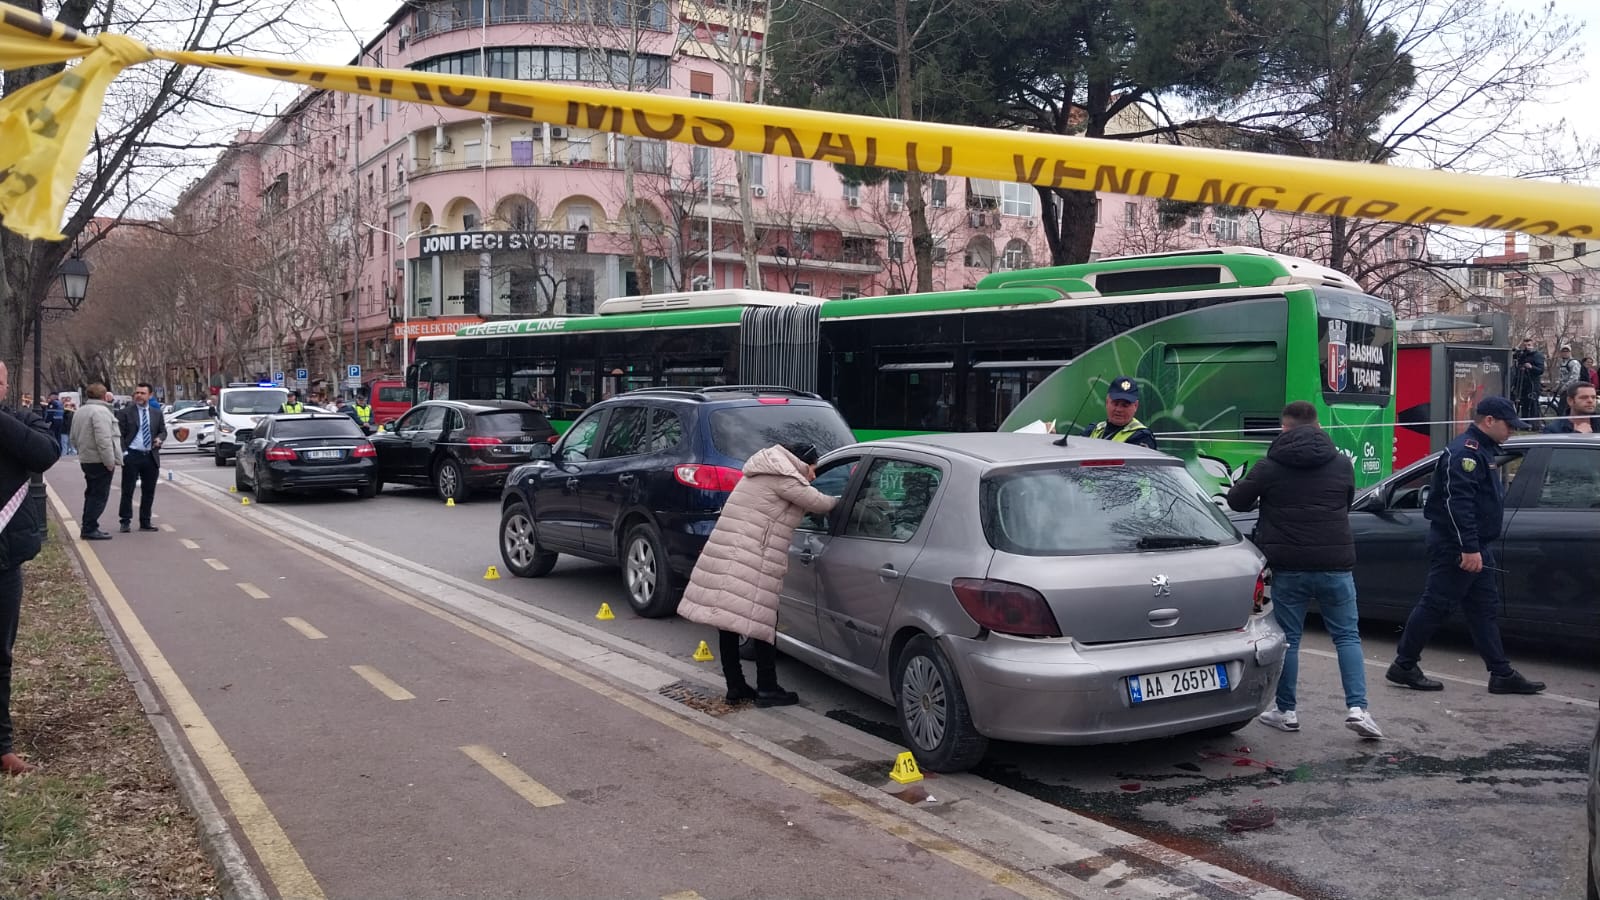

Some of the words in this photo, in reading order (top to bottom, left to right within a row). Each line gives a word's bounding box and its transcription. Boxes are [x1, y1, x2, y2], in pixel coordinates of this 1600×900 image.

[423, 236, 455, 253] JONI
[460, 233, 503, 250] PECI
[509, 233, 576, 250] STORE
[465, 321, 519, 336] GREEN
[525, 319, 567, 332] LINE
[1349, 342, 1384, 365] BASHKIA
[1363, 441, 1375, 457] Go
[1146, 676, 1164, 698] AA
[1171, 667, 1217, 693] 265PY
[903, 758, 915, 773] 13
